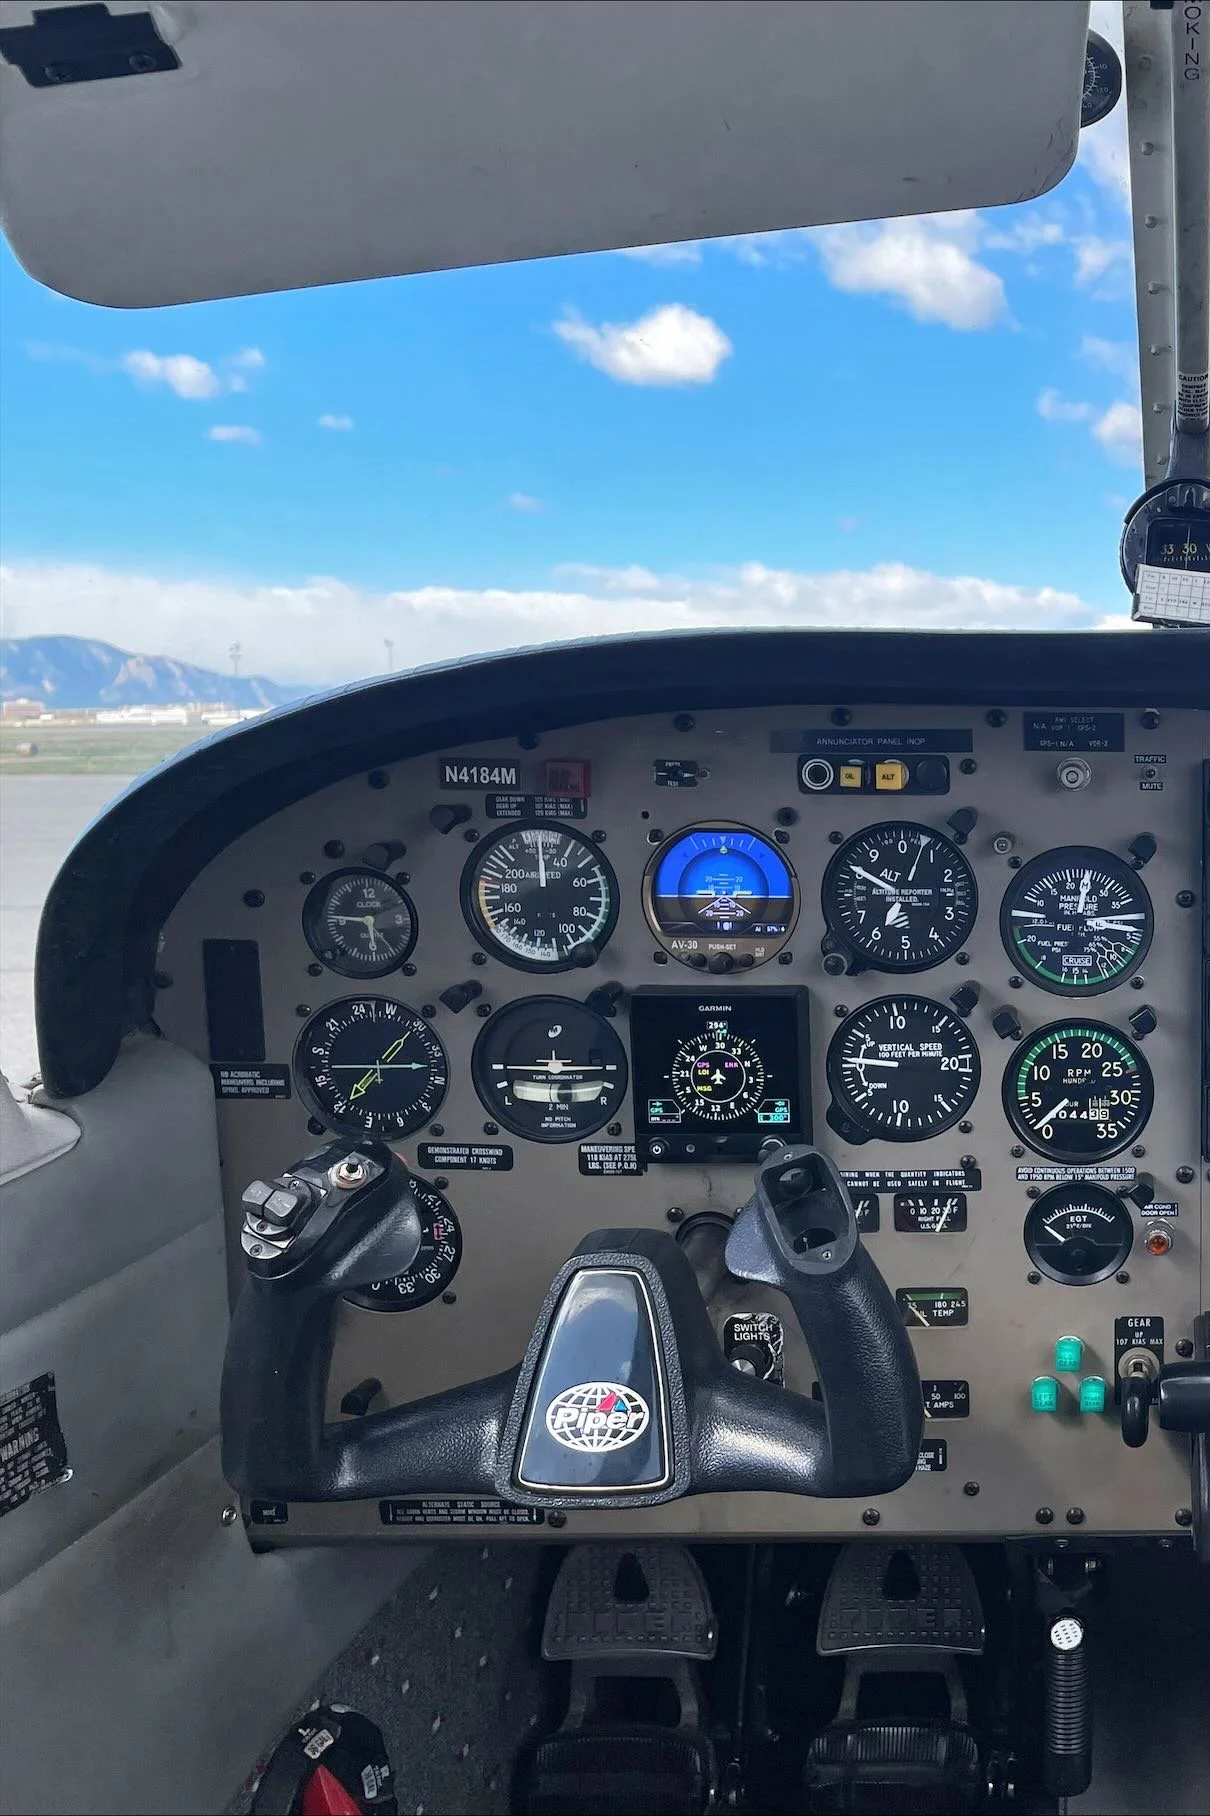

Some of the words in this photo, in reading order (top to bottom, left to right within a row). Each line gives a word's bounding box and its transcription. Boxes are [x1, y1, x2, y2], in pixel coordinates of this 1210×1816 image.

[1185, 0, 1201, 81] OKING
[1179, 374, 1209, 382] CAUTION
[816, 738, 872, 746] ANNUNCIATOR
[877, 737, 901, 746] PANEL
[907, 737, 926, 745] INOP
[445, 765, 516, 785] N4184M
[881, 773, 895, 781] ALT
[553, 858, 568, 868] 40
[505, 869, 525, 879] 200
[880, 868, 901, 882] ALT
[573, 878, 587, 887] 60
[501, 884, 517, 893] 180
[504, 903, 521, 913] 160
[573, 907, 587, 916] 80
[559, 924, 575, 933] 100
[671, 941, 698, 949] AV-30
[1064, 956, 1091, 965] CRUISE
[920, 1043, 942, 1051] SPEED
[1081, 1043, 1102, 1058] 20
[1053, 1044, 1068, 1060] 15
[1034, 1065, 1050, 1080] 10
[1102, 1062, 1123, 1077] 25
[1110, 1090, 1131, 1105] 30
[1097, 1124, 1118, 1138] 35
[427, 1147, 469, 1155] DEMONSTRATED
[935, 1301, 947, 1309] 180
[933, 1309, 954, 1317] TEMP
[1128, 1318, 1151, 1327] GEAR
[734, 1324, 773, 1332] SWITCH
[734, 1332, 771, 1341] LIGHTS
[553, 1406, 644, 1436] Piper
